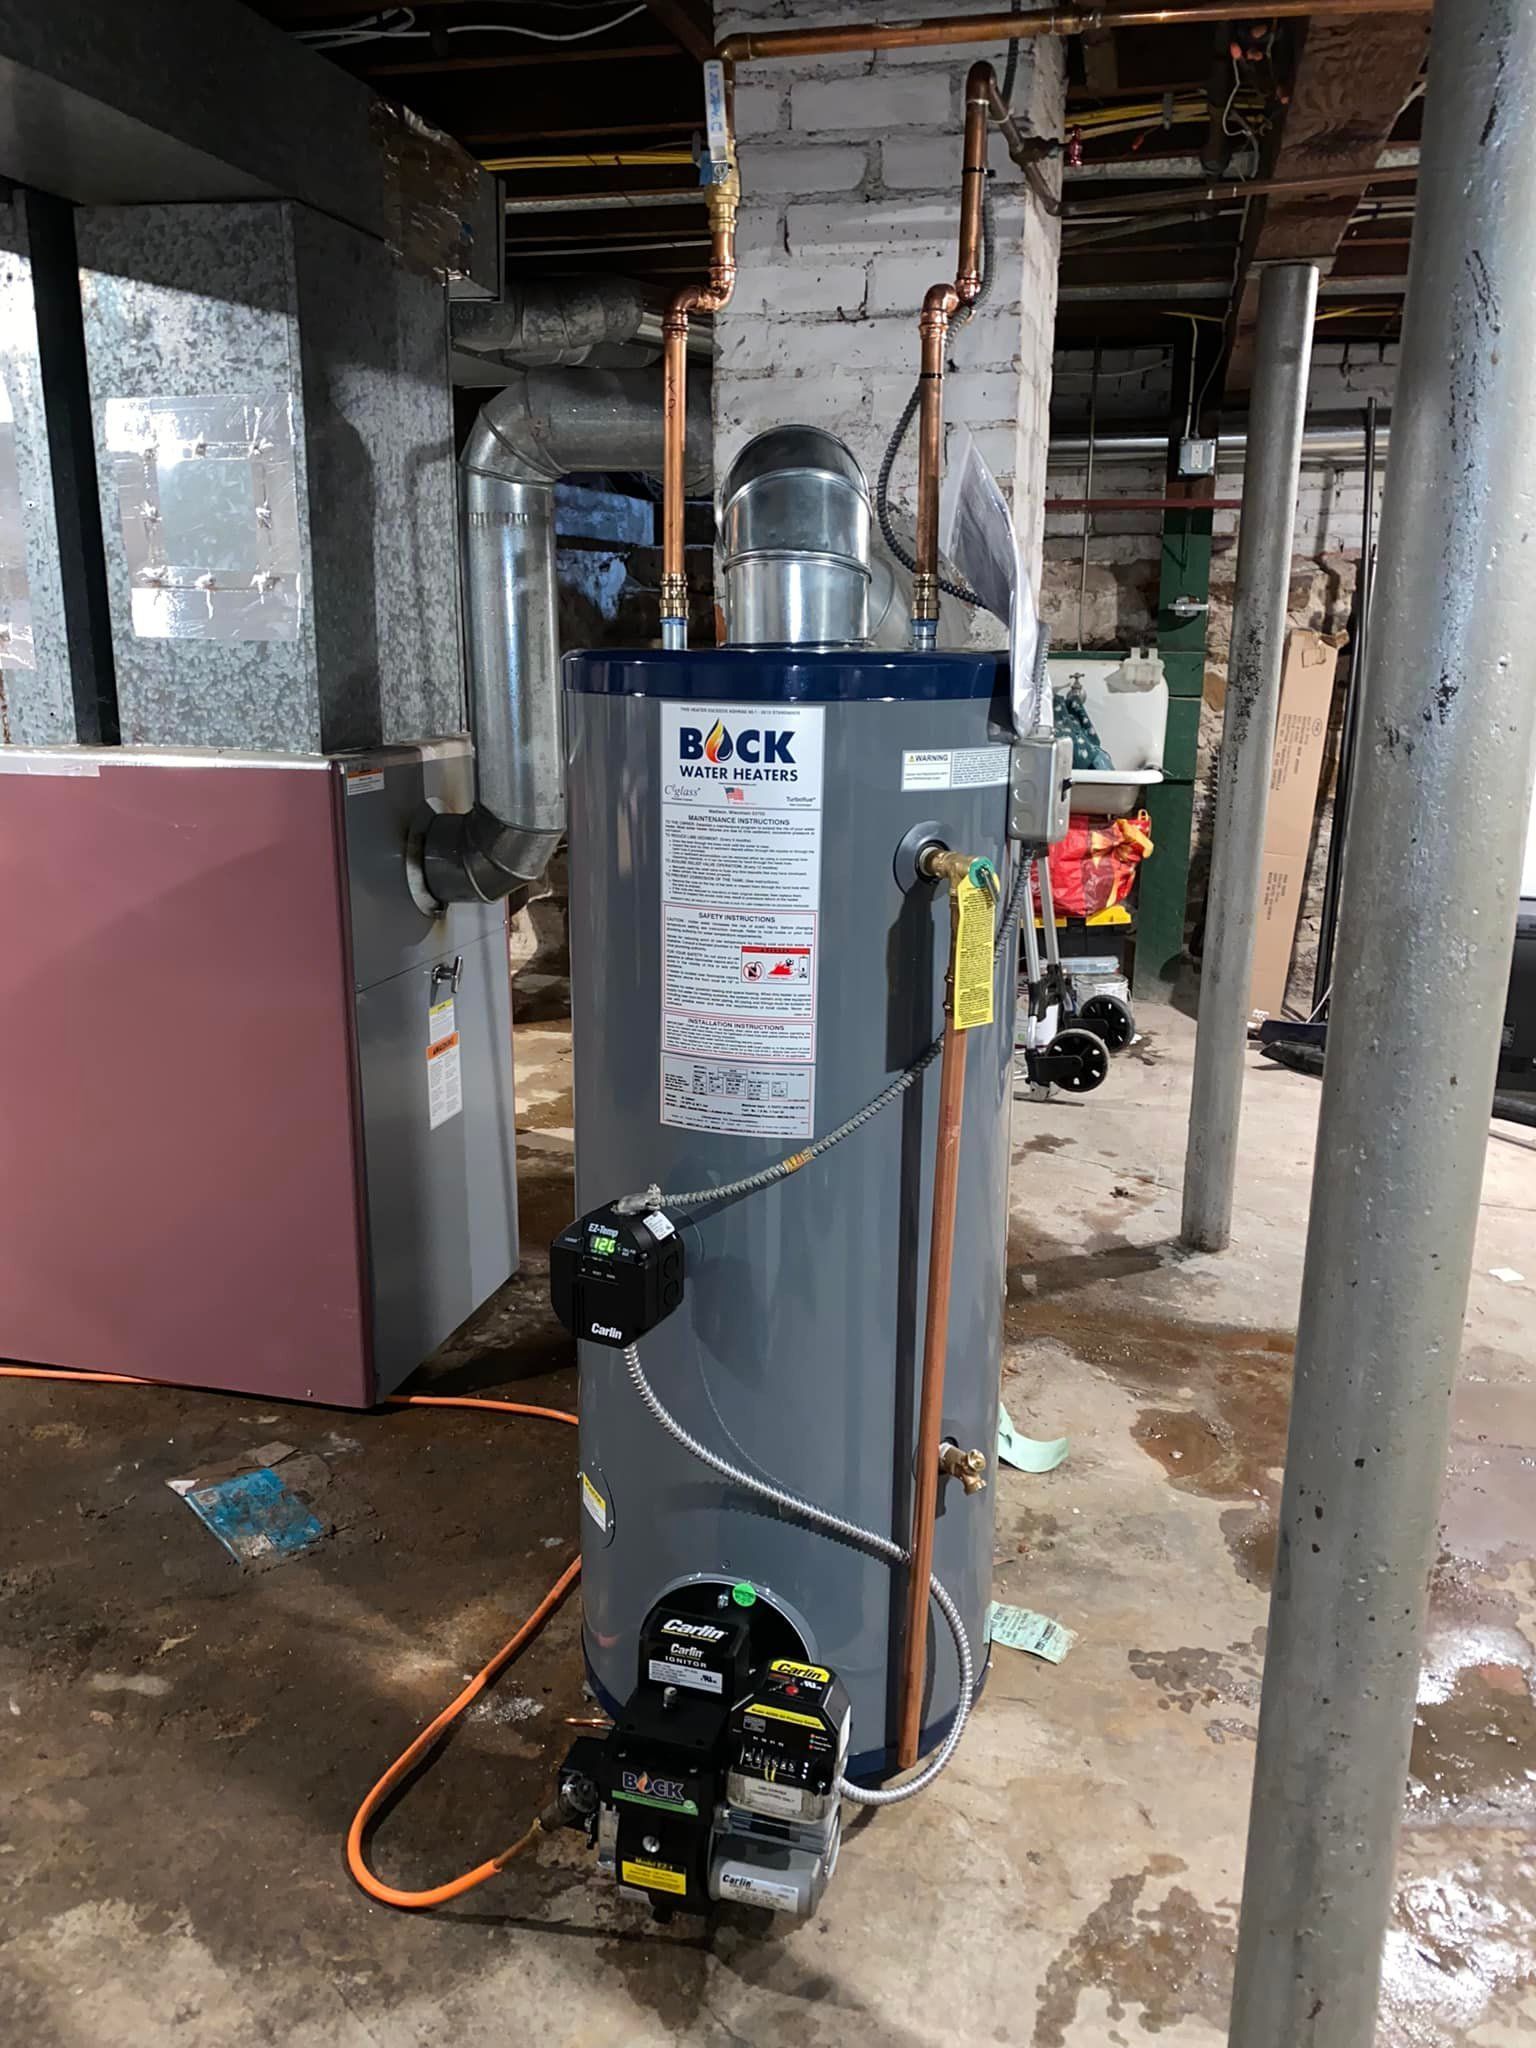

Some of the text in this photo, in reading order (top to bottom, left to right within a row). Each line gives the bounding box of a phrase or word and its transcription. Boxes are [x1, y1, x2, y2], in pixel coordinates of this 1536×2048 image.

[680, 718, 796, 764] BOCK
[915, 754, 949, 762] WARNING
[680, 765, 799, 783] WATER HEATERS
[688, 814, 790, 826] MAINTENANCE INSTRUCTIONS
[698, 911, 775, 923] SAFETY INSTRUCTIONS
[688, 1018, 784, 1031] INSTALLATION INSTRUCTIONS
[591, 1322, 623, 1340] Carlin
[663, 1619, 725, 1640] Carlin
[671, 1643, 703, 1658] Carlin
[665, 1656, 707, 1669] IGNITOR
[777, 1663, 822, 1680] Carlin
[722, 1874, 752, 1889] Carlin
